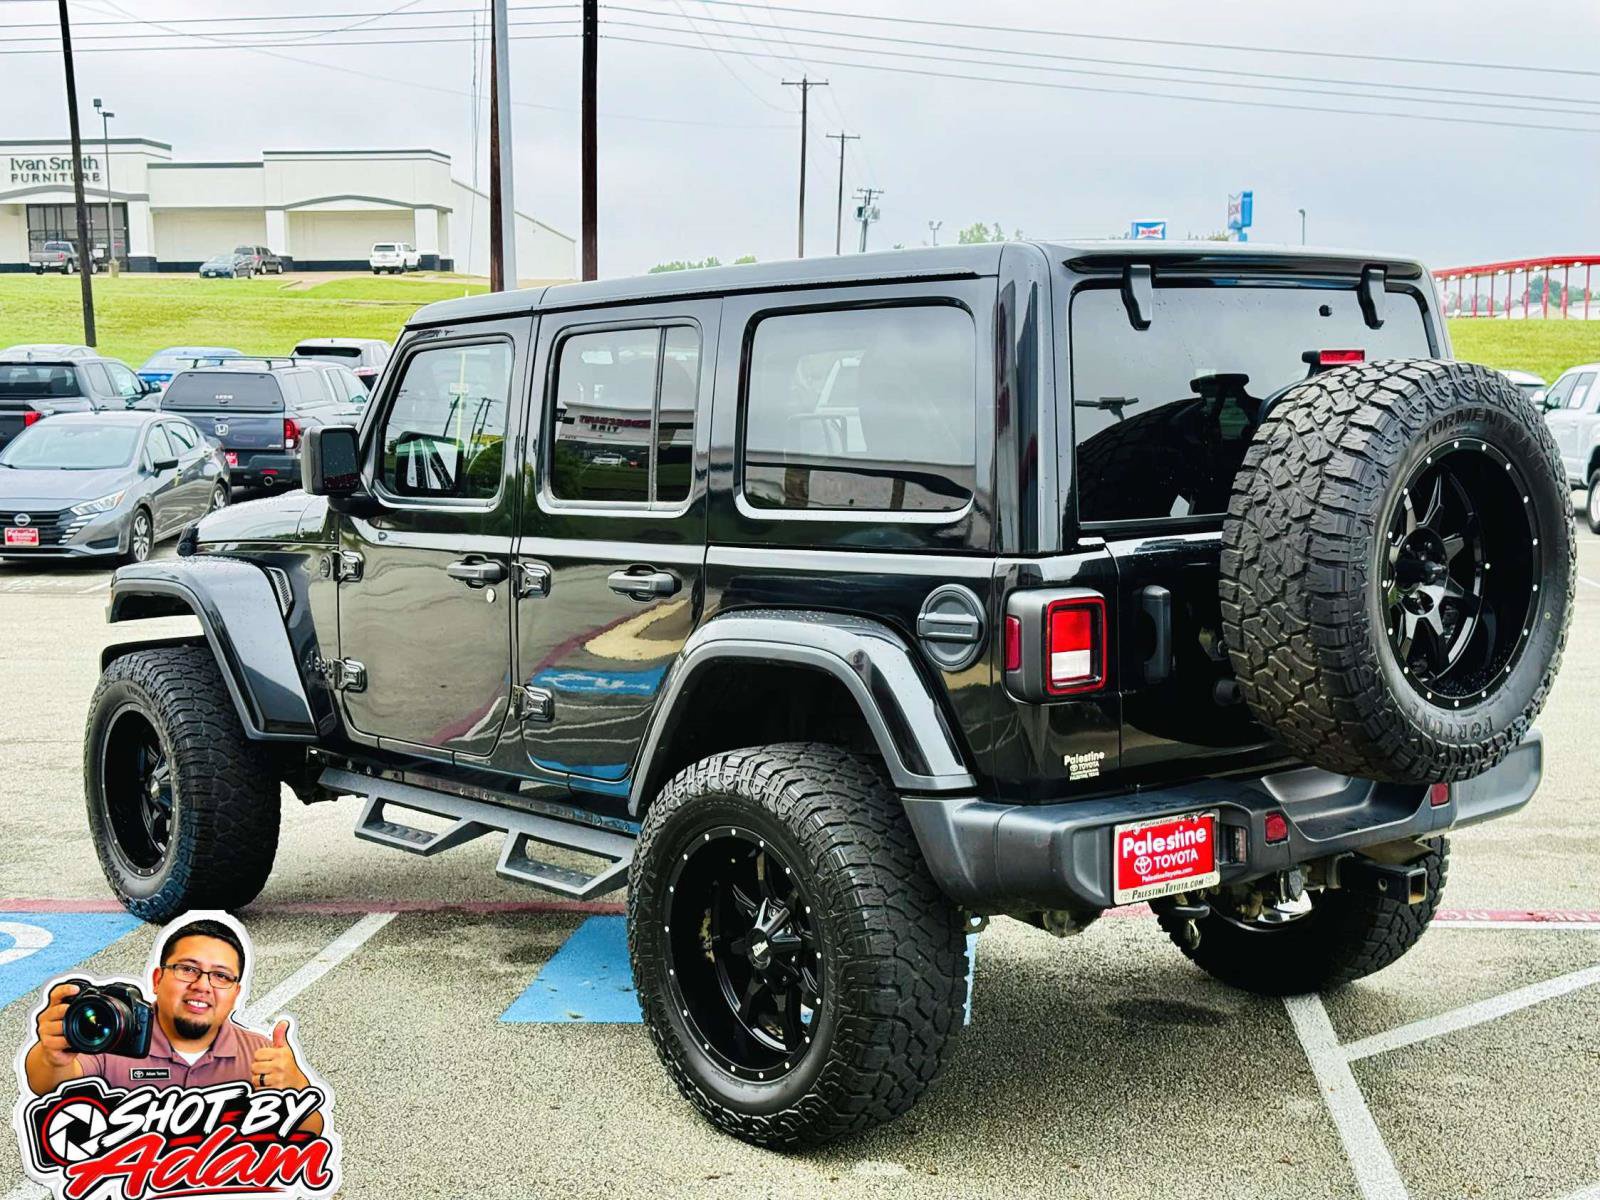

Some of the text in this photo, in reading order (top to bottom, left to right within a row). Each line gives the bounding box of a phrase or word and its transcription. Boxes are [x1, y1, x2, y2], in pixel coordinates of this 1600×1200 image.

[10, 155, 99, 171] Ivan Smth
[1063, 750, 1105, 766] Palestine
[1078, 760, 1100, 771] TOYOTA
[1122, 825, 1207, 859] Palestine
[1153, 848, 1199, 869] TOYOTA
